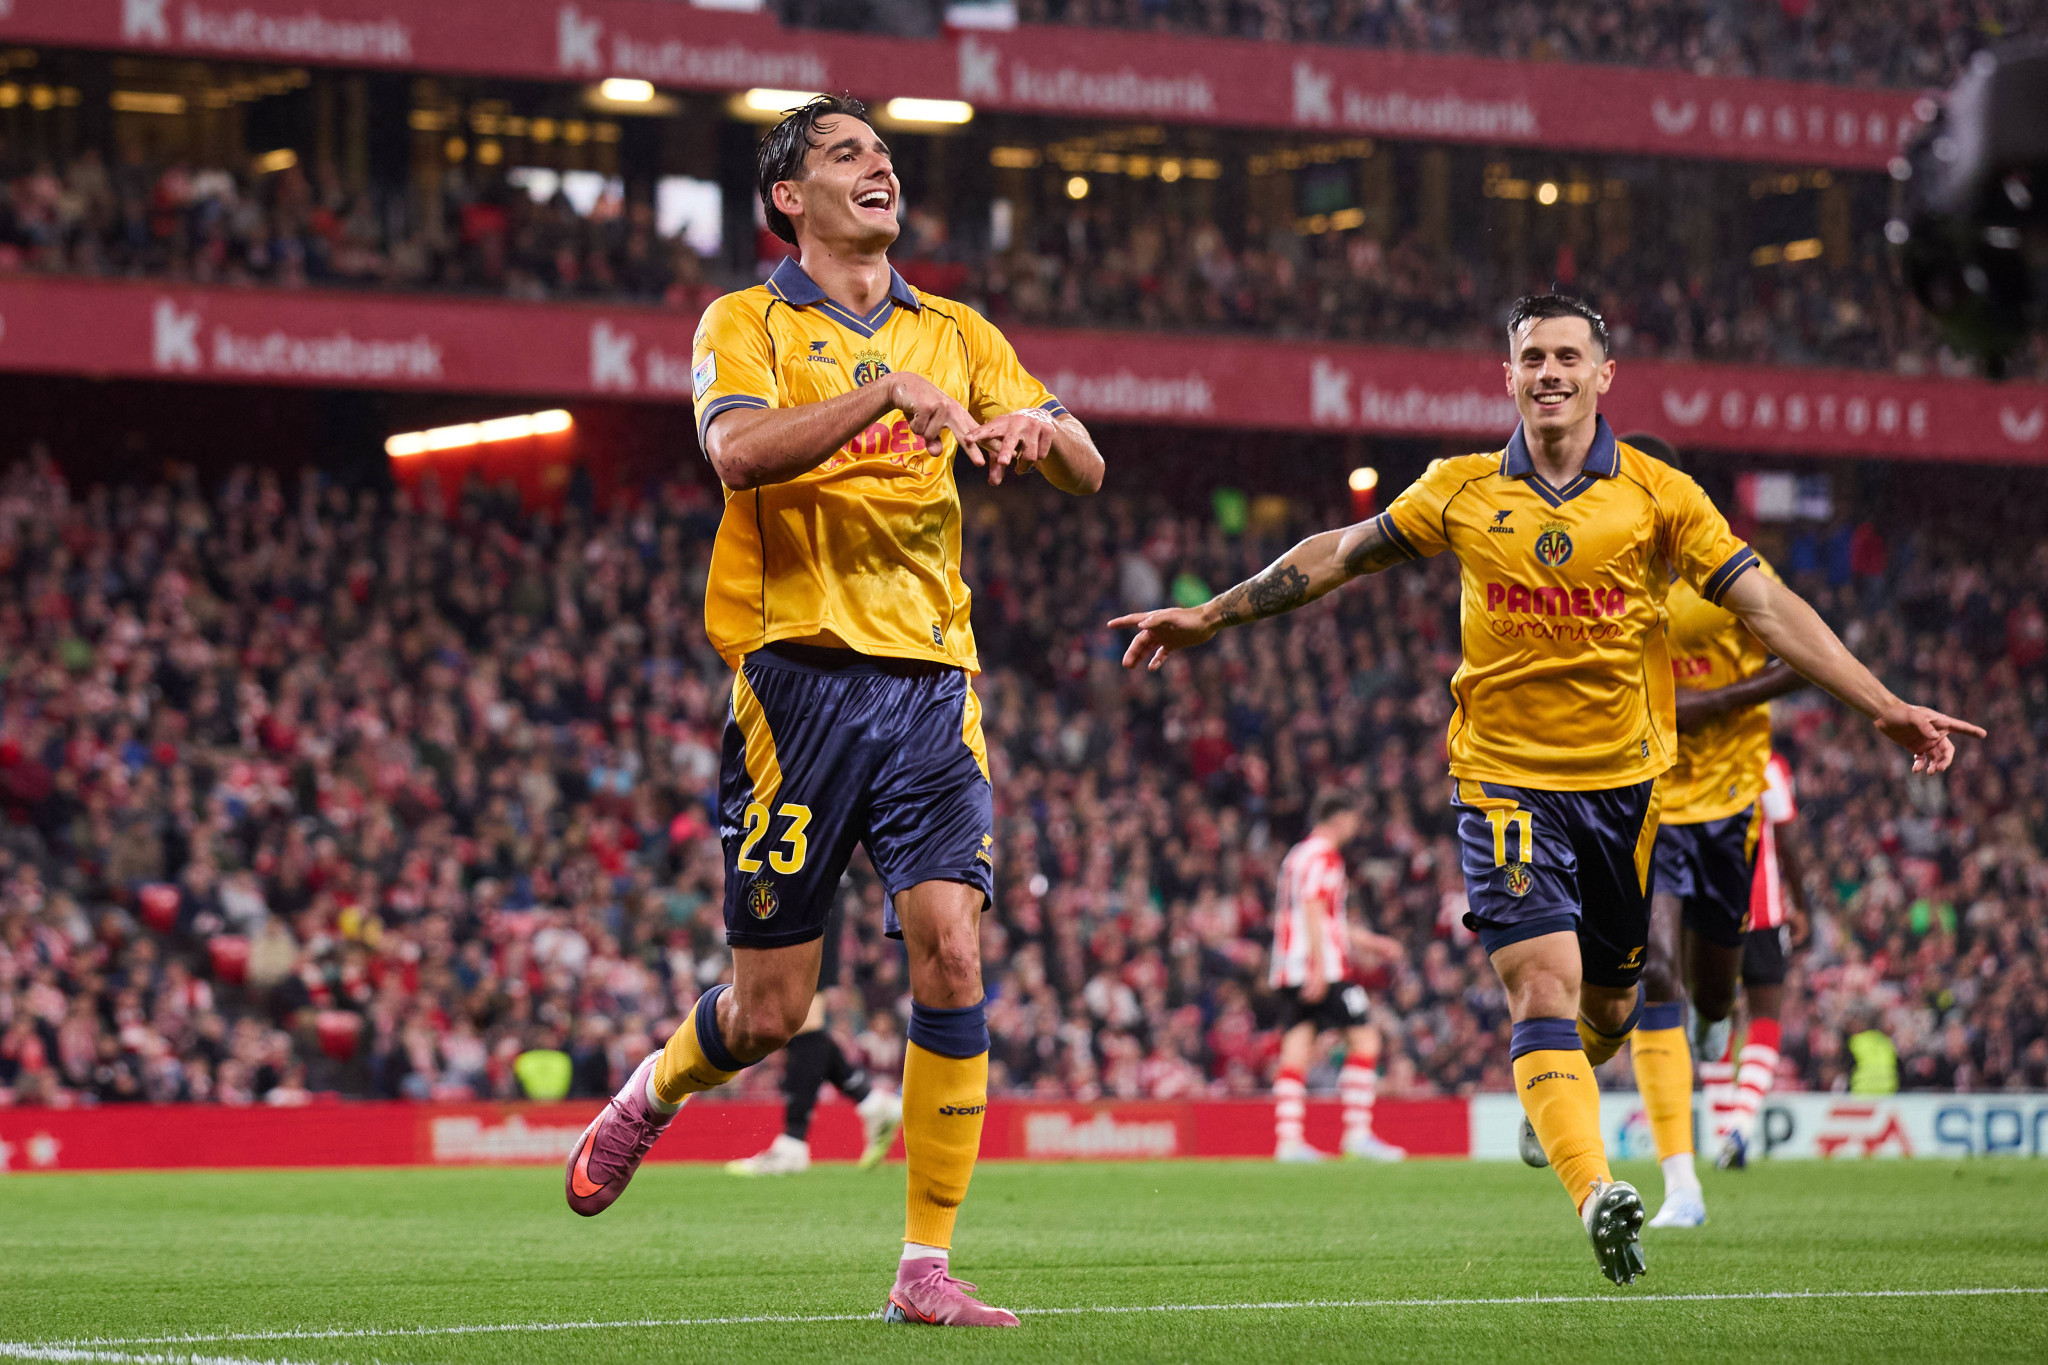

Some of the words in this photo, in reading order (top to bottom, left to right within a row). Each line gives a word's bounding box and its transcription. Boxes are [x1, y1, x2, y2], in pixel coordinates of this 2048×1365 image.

[807, 354, 837, 365] Joma
[1487, 526, 1514, 534] Joma
[1487, 583, 1627, 617] PAMESA
[738, 802, 812, 874] 23
[1485, 809, 1533, 867] 11
[1526, 1071, 1579, 1090] Joma
